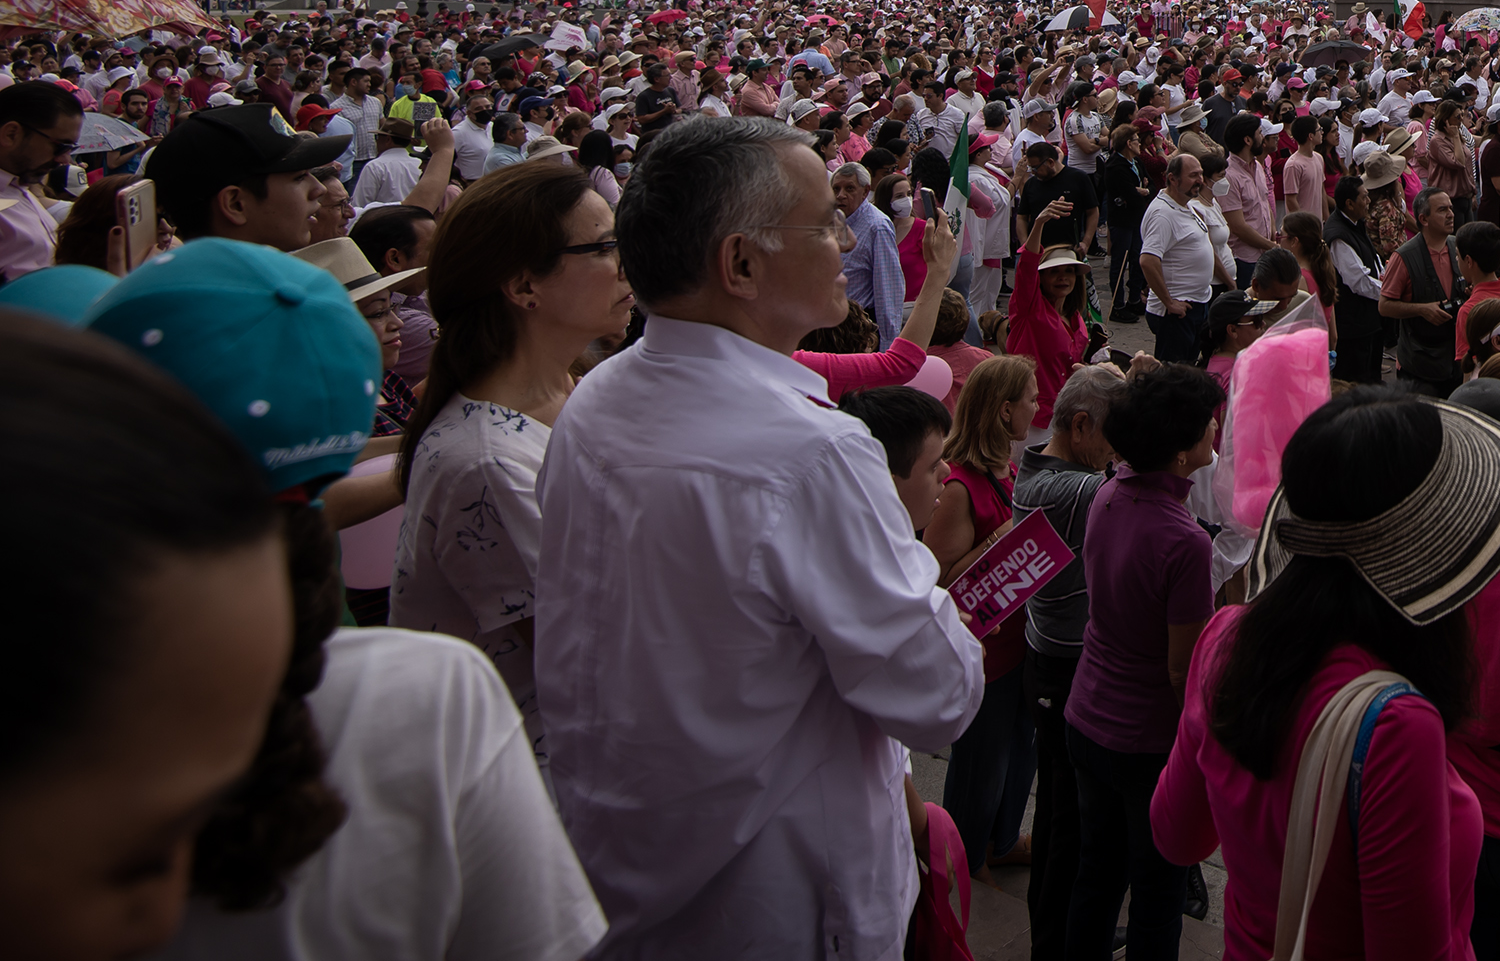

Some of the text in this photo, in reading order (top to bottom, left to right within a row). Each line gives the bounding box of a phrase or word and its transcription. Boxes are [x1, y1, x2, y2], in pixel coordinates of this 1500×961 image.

[954, 559, 991, 595] #YO
[961, 538, 1039, 611] DEFIENDO
[993, 550, 1056, 610] INE
